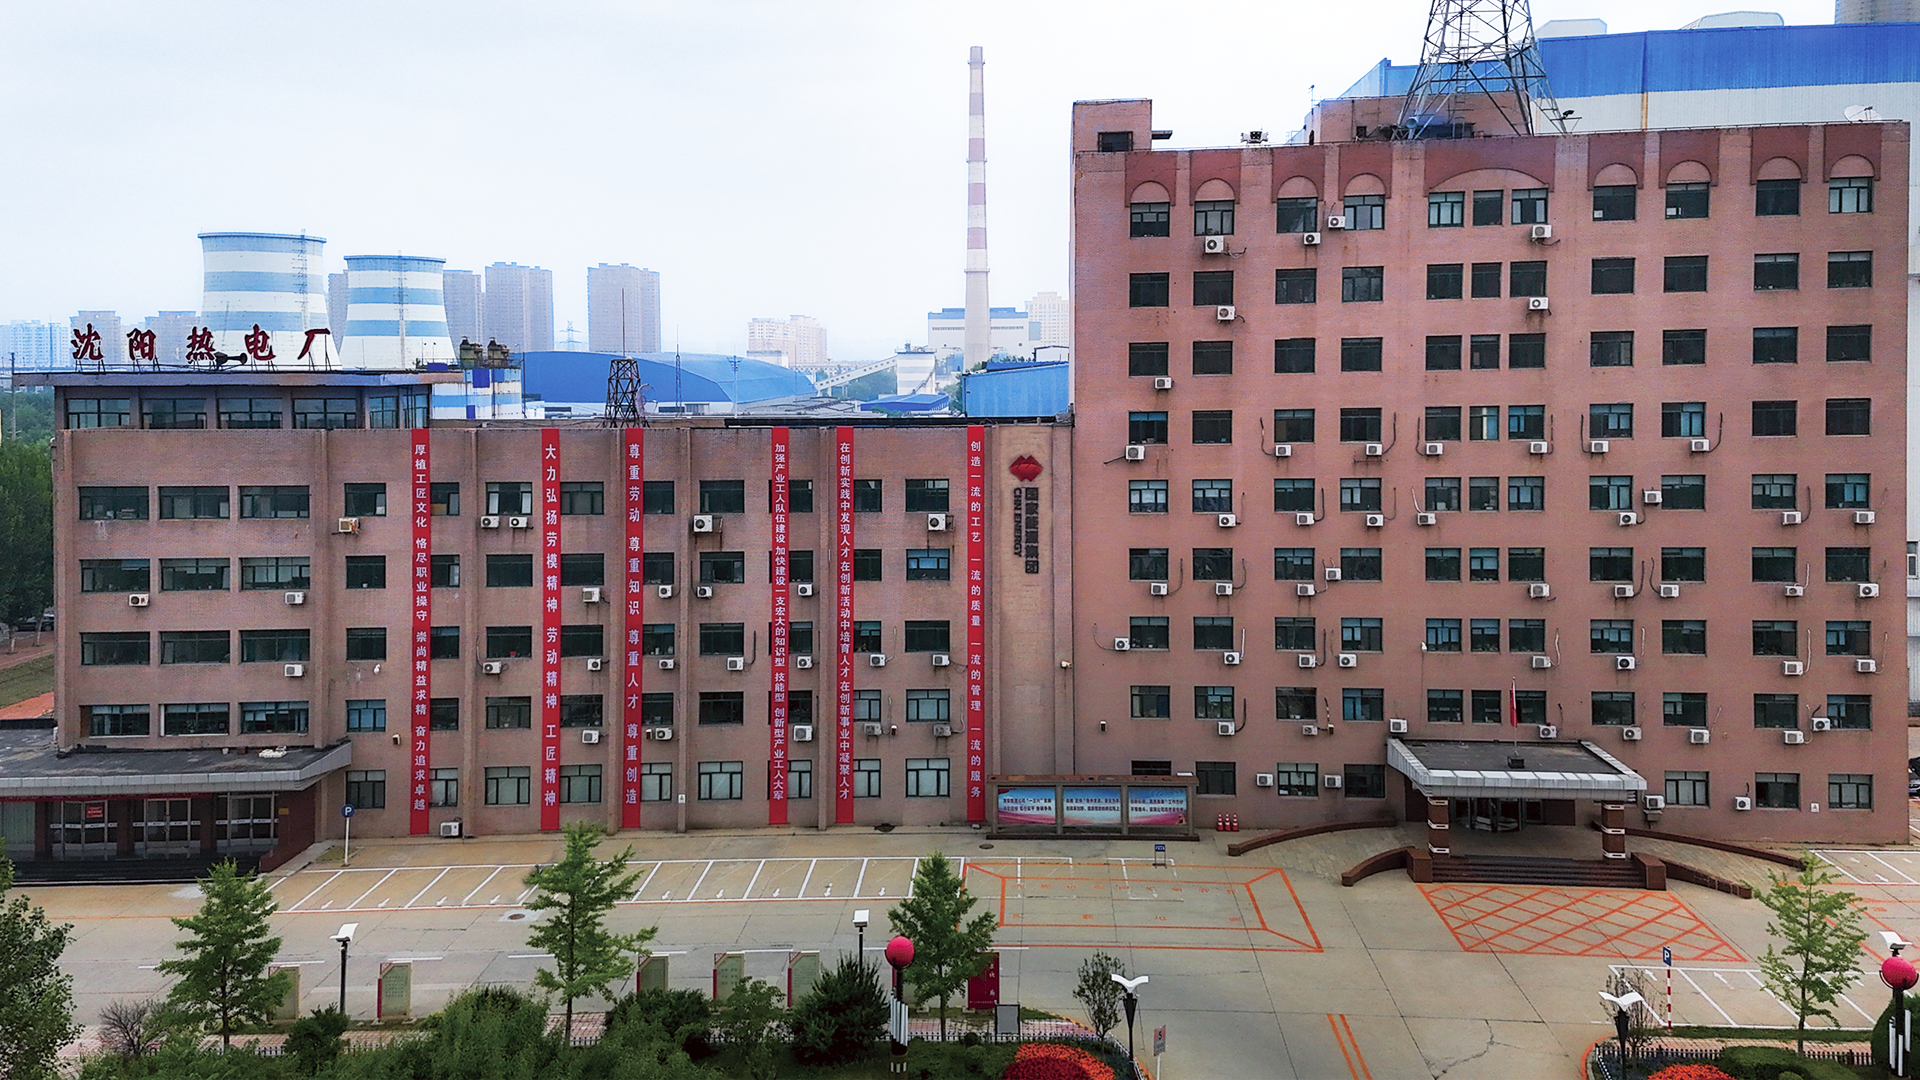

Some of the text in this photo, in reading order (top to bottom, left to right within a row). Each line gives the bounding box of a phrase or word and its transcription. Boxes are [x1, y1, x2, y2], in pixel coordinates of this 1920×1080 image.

[71, 323, 331, 364] 沈阳热电厂
[1014, 487, 1022, 558] CHN ENERGY
[414, 444, 427, 811] 厚植工匠文化 恪尽职业操守 崇尚精益求精 奋力追求卓越
[545, 443, 558, 807] 大力弘扬劳模精神 劳动精神 工匠精神
[626, 443, 640, 805] 尊重劳动 尊重知识 尊重人才 尊重创造
[970, 440, 981, 798] 创造一流的工艺 一流的质量 一流的管理 一流的服务
[773, 707, 784, 800] 创新型产业工人大军
[839, 680, 850, 800] 在创新事业中凝聚人才
[345, 806, 352, 816] P
[1664, 950, 1670, 961] P
